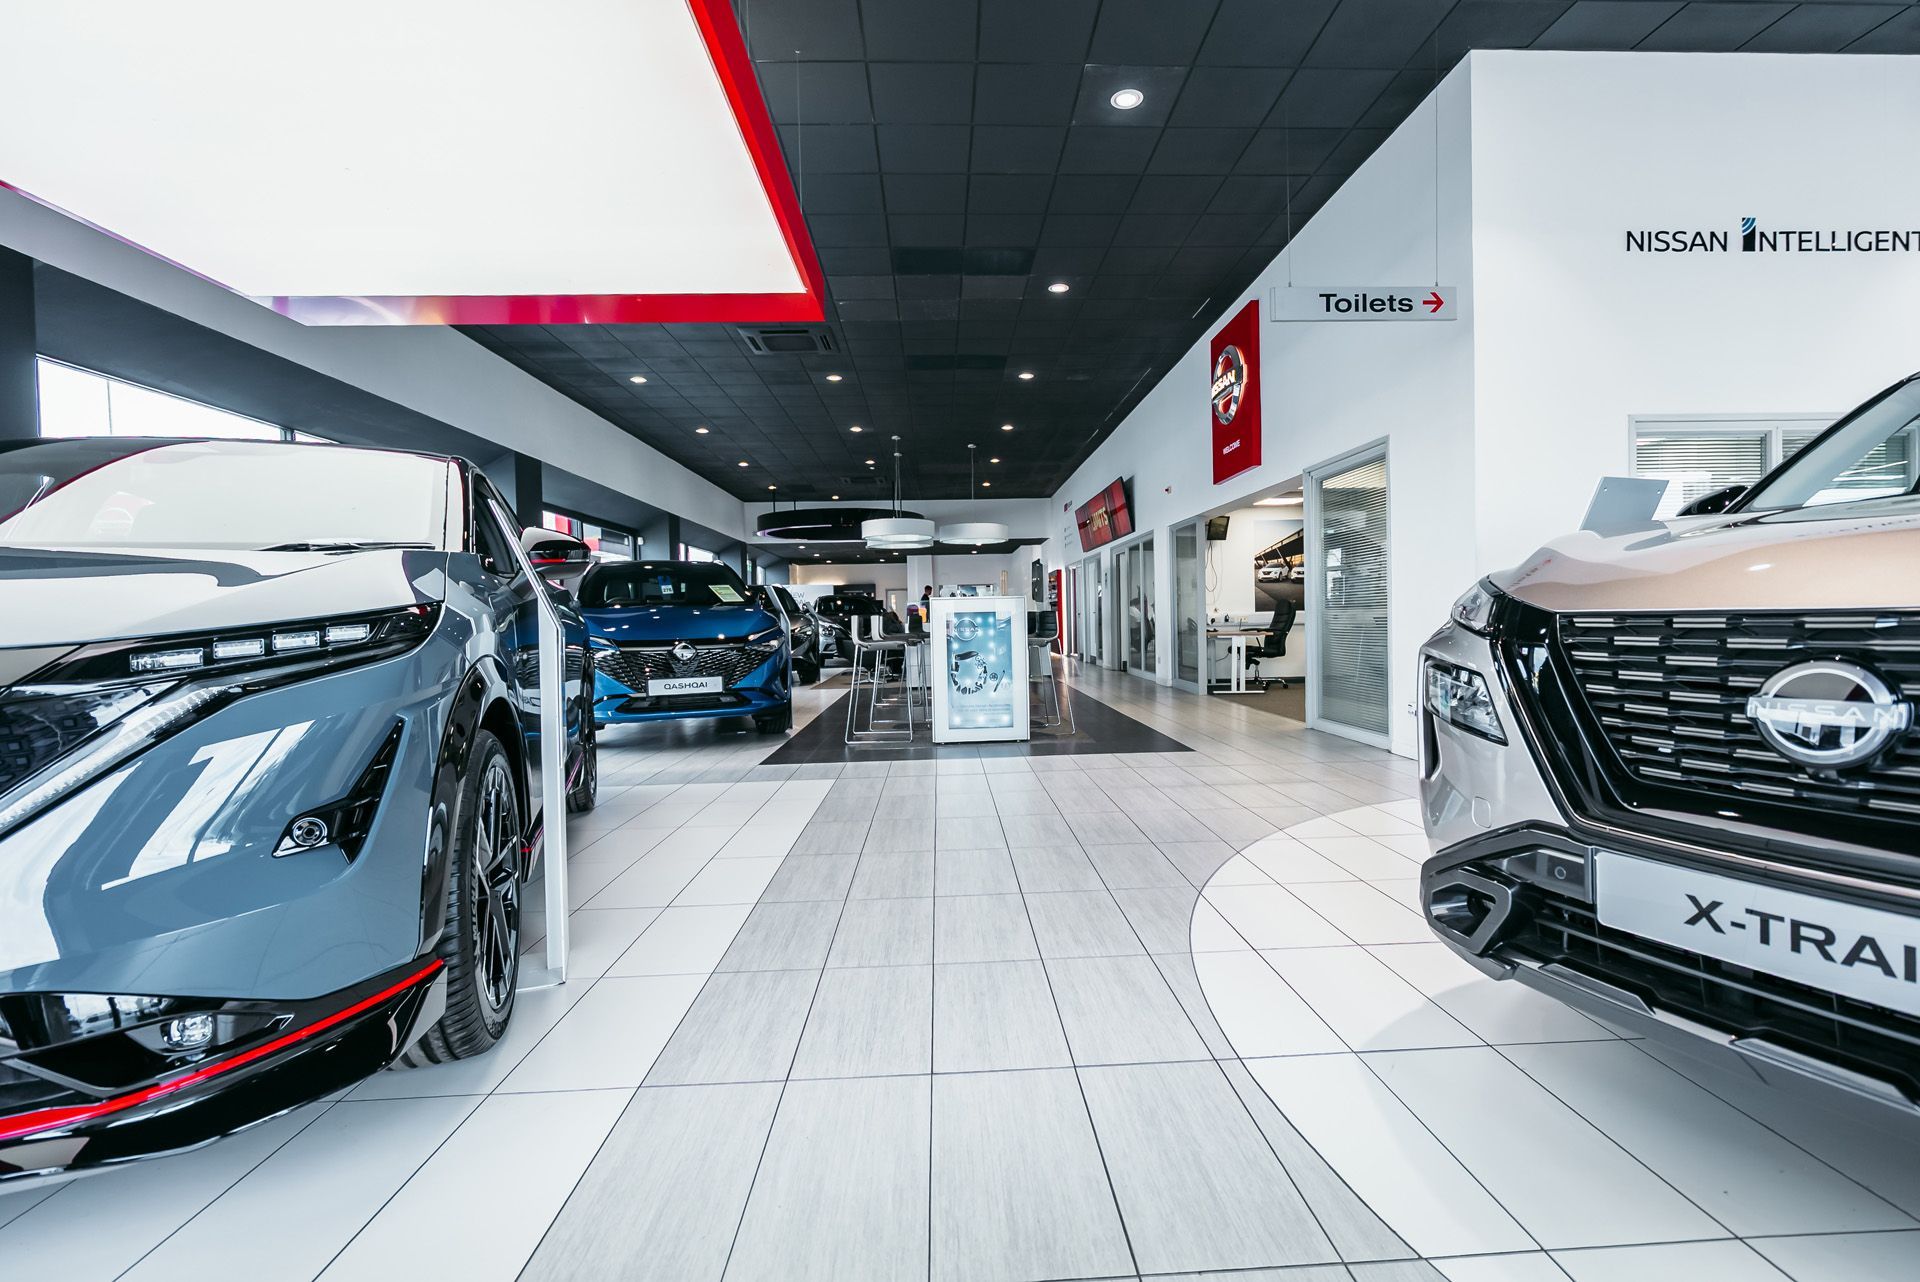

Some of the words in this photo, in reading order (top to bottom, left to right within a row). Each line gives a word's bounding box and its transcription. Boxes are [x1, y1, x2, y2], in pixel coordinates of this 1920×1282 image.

[1626, 231, 1728, 252] NISSAN
[1319, 293, 1414, 313] Toilets
[664, 682, 708, 690] QASHQAI
[1752, 700, 1898, 725] NISSAN
